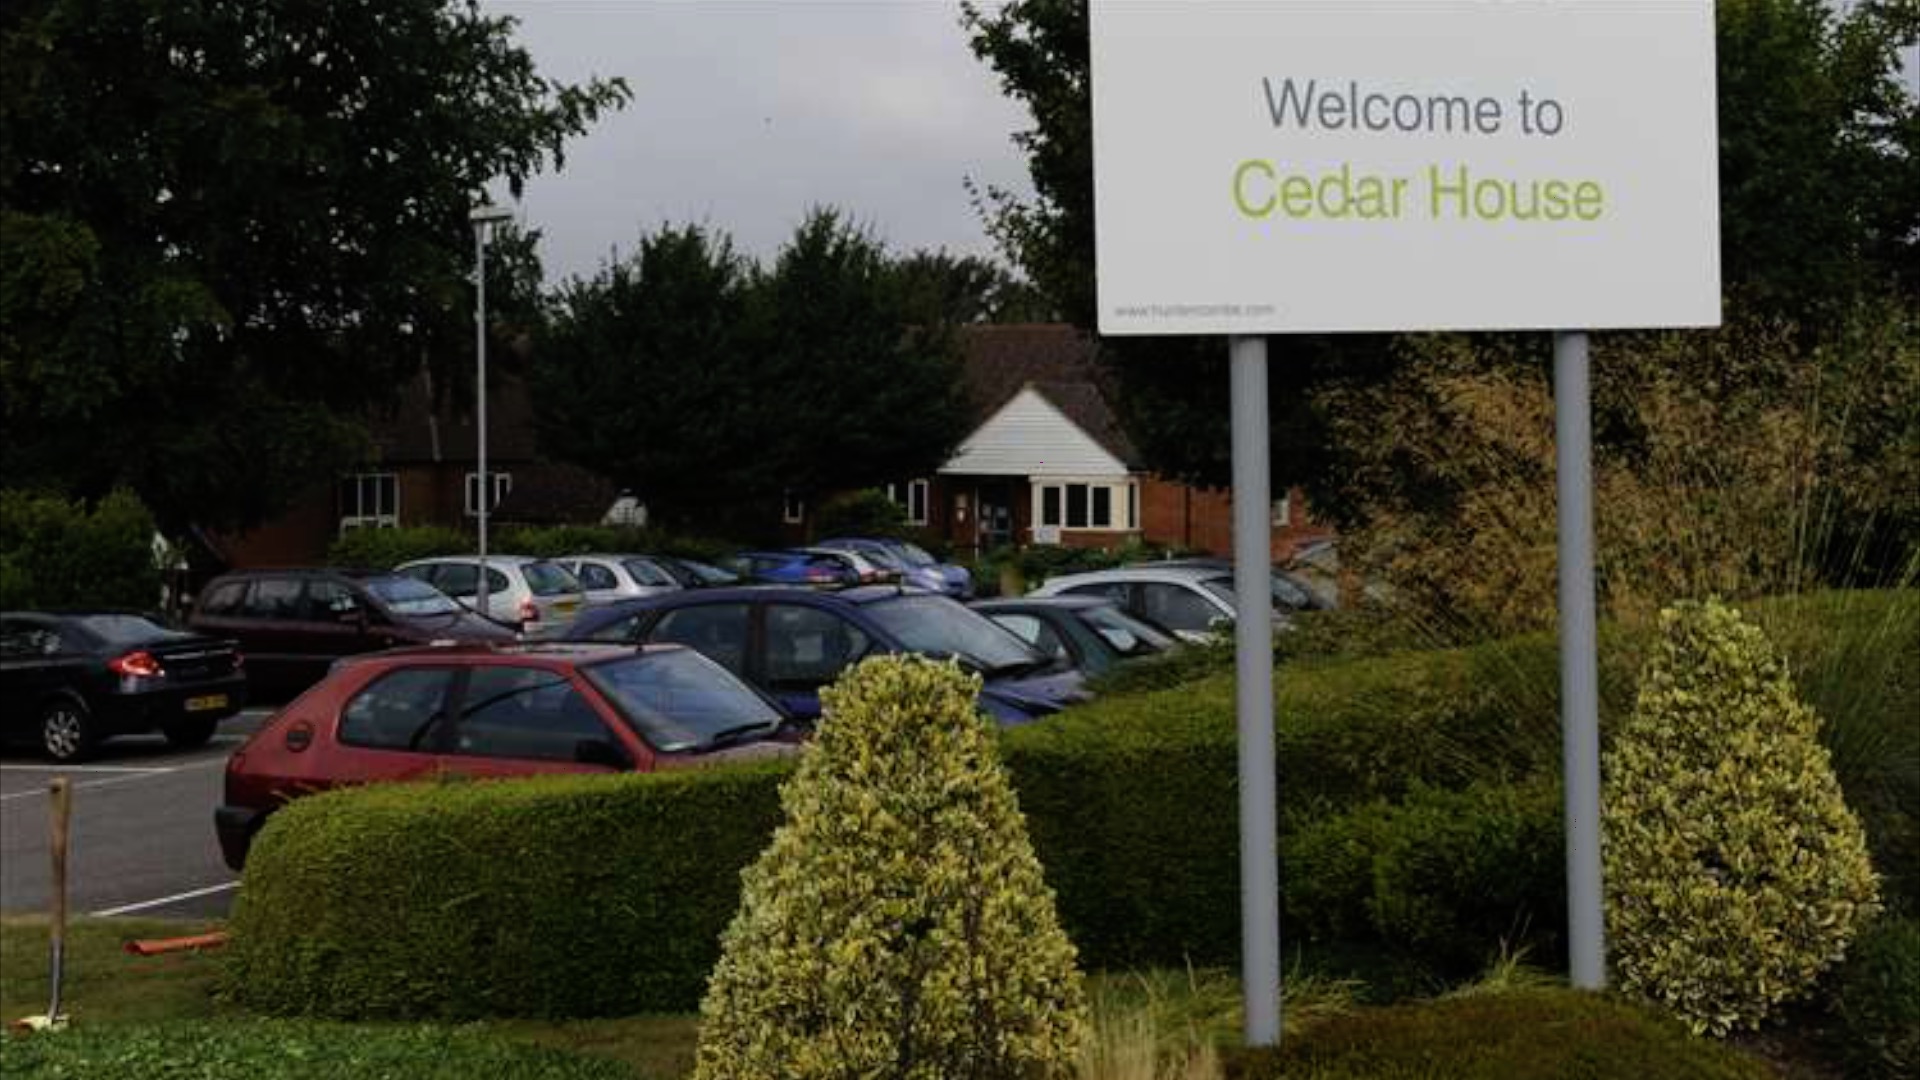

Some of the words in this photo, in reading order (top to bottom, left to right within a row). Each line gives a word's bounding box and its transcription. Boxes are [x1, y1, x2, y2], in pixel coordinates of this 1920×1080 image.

[1262, 76, 1503, 135] Welcome
[1518, 88, 1564, 136] to
[1232, 158, 1408, 220] Cedar
[1428, 165, 1604, 222] House
